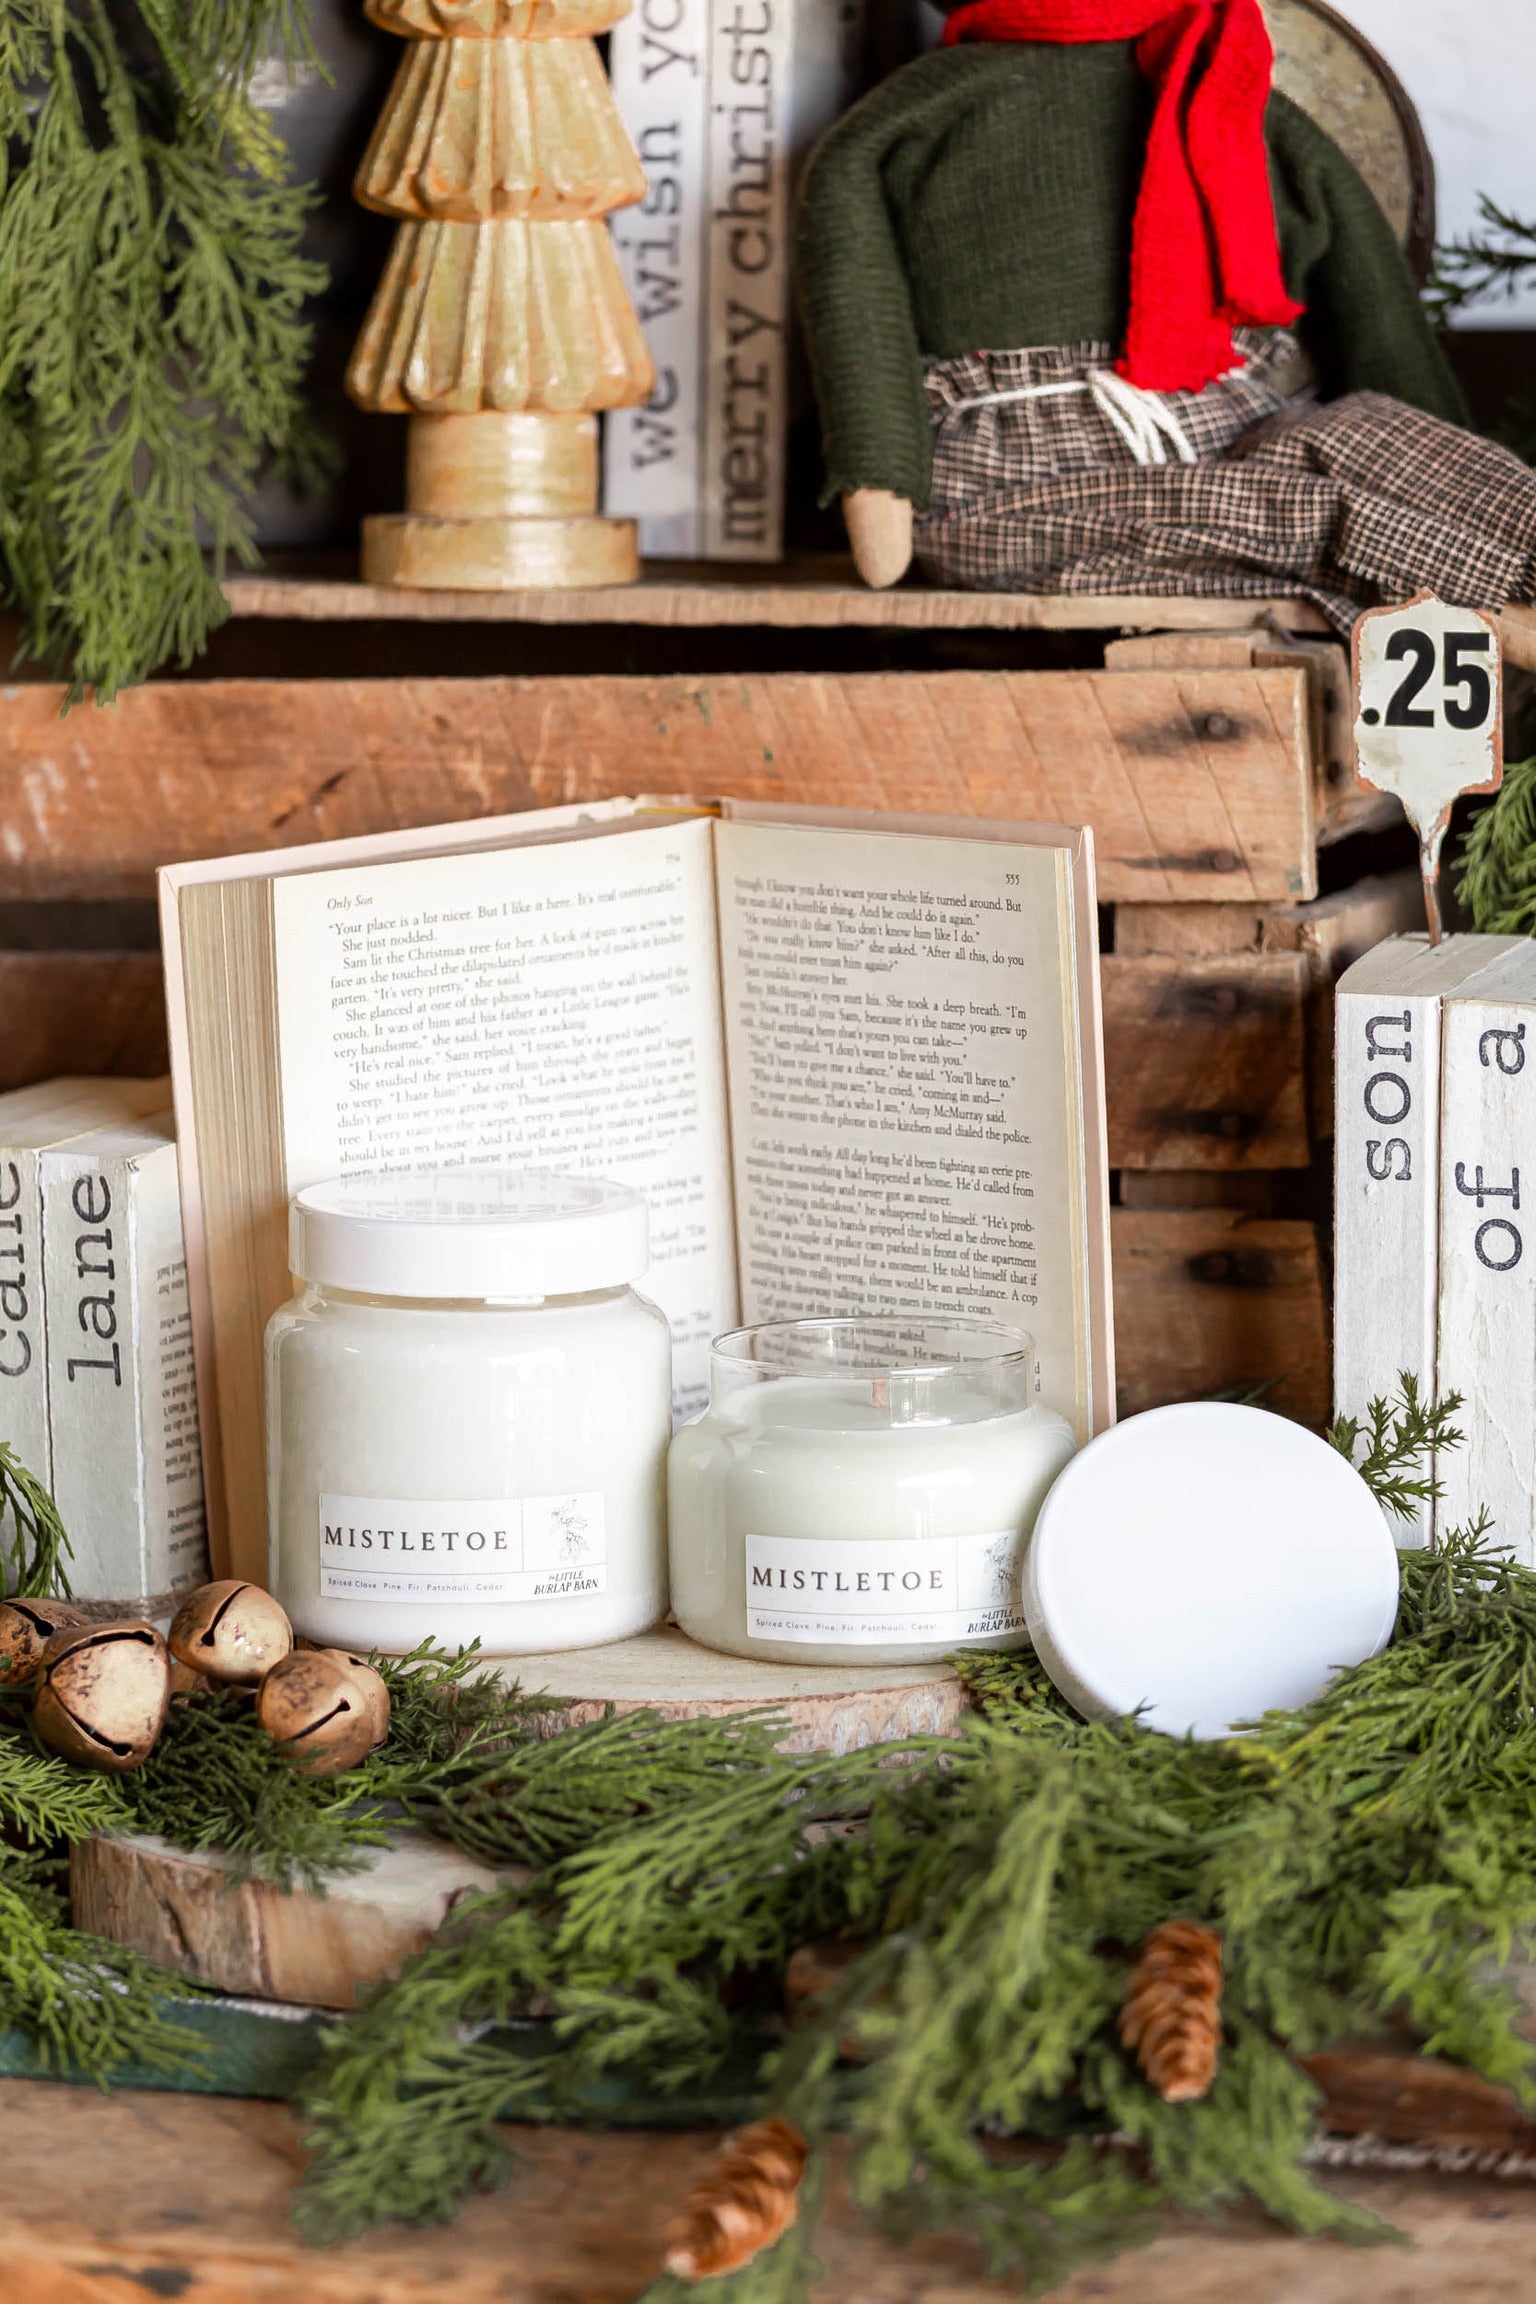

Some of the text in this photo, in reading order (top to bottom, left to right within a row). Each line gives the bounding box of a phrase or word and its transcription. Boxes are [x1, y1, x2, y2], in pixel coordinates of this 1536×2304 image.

[720, 302, 785, 544] merry
[1362, 628, 1490, 730] .25
[1005, 873, 1020, 885] 555
[327, 895, 373, 911] Only Son
[920, 890, 1022, 912] life turned around. But
[328, 922, 362, 935] "Your
[366, 918, 396, 935] place
[400, 916, 408, 929] is
[412, 918, 418, 927] a
[422, 912, 438, 926] lot
[478, 906, 498, 919] But
[860, 904, 879, 918] And
[882, 905, 892, 919] he
[896, 908, 922, 921] could
[924, 908, 938, 922] do
[940, 910, 946, 923] it
[342, 927, 438, 951] She just nodded.
[934, 926, 980, 942] like I do."
[342, 945, 465, 970] Sam lit the Christmas
[888, 941, 1024, 967] asked. "After all this, do you
[330, 960, 458, 989] face as she touched the
[373, 986, 396, 1000] "It's
[400, 986, 422, 998] very
[345, 1001, 426, 1021] She glanced at
[932, 999, 1026, 1019] a deep breath. "I'm
[332, 1016, 450, 1040] couch. It was of him
[922, 1015, 1027, 1039] the name you grew up
[912, 1035, 928, 1045] can
[334, 1047, 356, 1059] very
[899, 1048, 916, 1062] live
[918, 1051, 940, 1064] with
[348, 1058, 380, 1073] "He's
[384, 1054, 404, 1070] real
[348, 1068, 441, 1090] She studied the
[914, 1068, 936, 1081] said.
[939, 1069, 972, 1085] "You'll
[974, 1072, 996, 1087] have
[960, 1089, 968, 1102] in
[1364, 1010, 1412, 1180] son
[908, 1102, 1006, 1124] Amy McMurray said.
[934, 1122, 1032, 1144] and dialed the police.
[1455, 1023, 1525, 1271] of a
[938, 1156, 1032, 1179] fighting an eerie pre-
[956, 1177, 1034, 1196] He'd called from
[941, 1209, 1035, 1232] himself. "He's prob-
[966, 1230, 1035, 1249] he drove home.
[959, 1247, 1036, 1266] of the apartment
[67, 1174, 121, 1387] lane
[950, 1264, 1036, 1284] told himself that if
[954, 1282, 1037, 1304] ambulance. A cop
[934, 1298, 994, 1315] trench coats.
[324, 1525, 508, 1551] MISTLETOE
[328, 1577, 352, 1587] Spiced
[555, 1570, 584, 1582] LITTLE
[752, 1566, 943, 1591] MISTLETOE
[534, 1578, 599, 1595] BURLAP BARN
[756, 1618, 782, 1629] Spiced
[988, 1608, 1014, 1620] LITTLE
[967, 1616, 1026, 1634] BURLAP BARN
